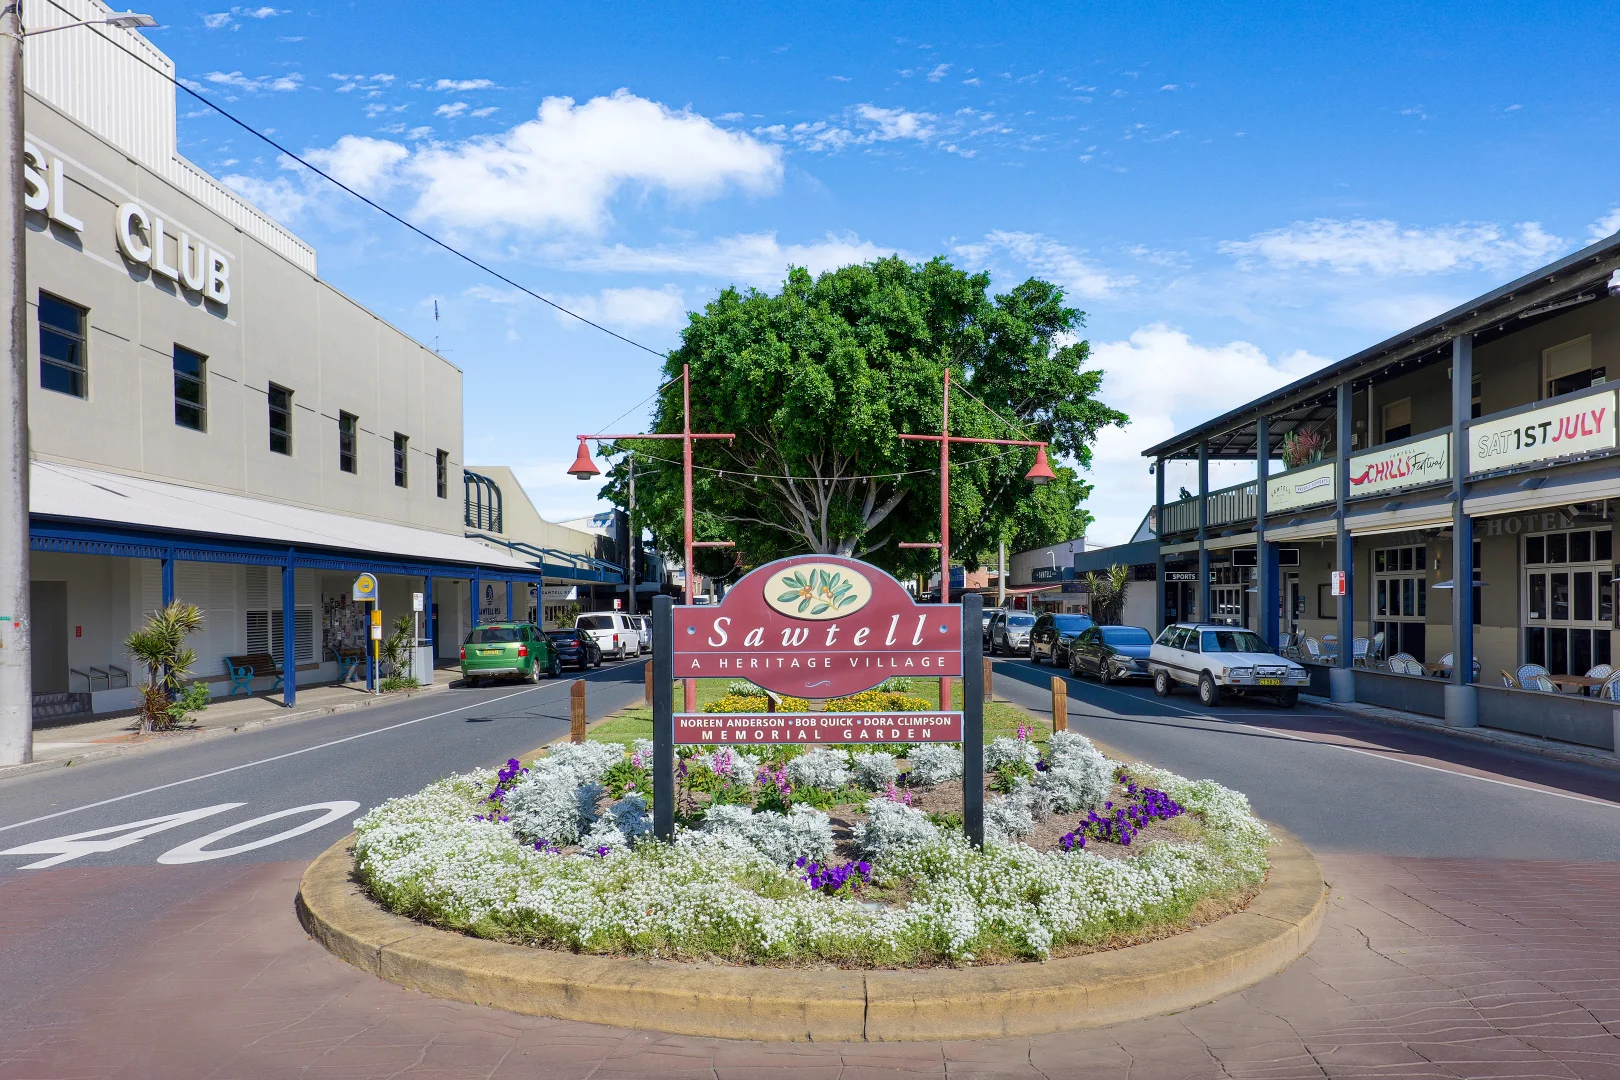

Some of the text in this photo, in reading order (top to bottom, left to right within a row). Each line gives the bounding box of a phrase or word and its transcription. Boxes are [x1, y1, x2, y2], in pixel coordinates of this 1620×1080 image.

[116, 202, 231, 305] CLUB
[1477, 407, 1606, 459] SAT 1ST JULY
[1367, 450, 1445, 484] CHILLI Festival
[1486, 511, 1575, 537] HOTEL
[708, 613, 927, 647] Sawtell
[691, 656, 945, 669] A HERITAGE VILLAGE
[680, 717, 951, 728] NOREEN ANDERSON BOB QUICK DORA CLIMPSON
[701, 728, 931, 740] MEMORIAL GARDEN
[0, 800, 361, 869] 40
